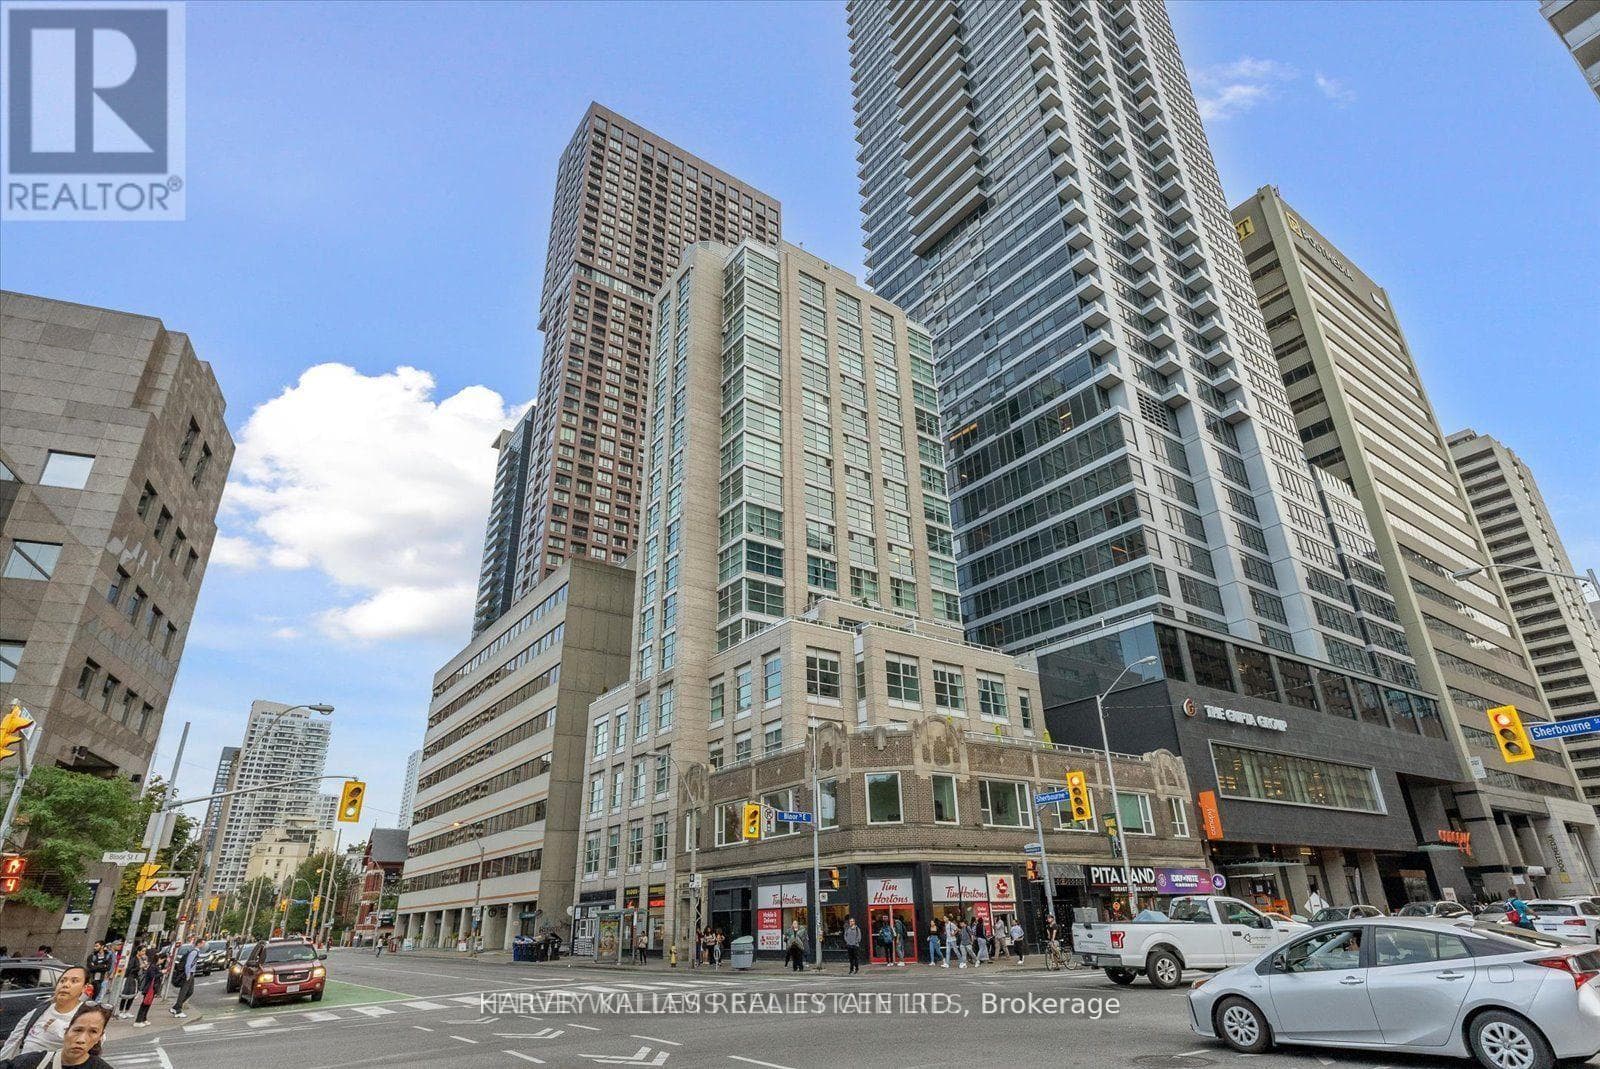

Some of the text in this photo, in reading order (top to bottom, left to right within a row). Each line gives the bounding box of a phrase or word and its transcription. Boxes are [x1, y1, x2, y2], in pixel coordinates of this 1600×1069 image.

[1533, 721, 1592, 738] Sherbourne
[1036, 793, 1066, 803] Sherbourne
[1090, 867, 1156, 884] PITA LAND
[880, 880, 898, 891] Tim
[782, 893, 803, 904] Hortons
[873, 892, 909, 904] Hortons
[945, 886, 960, 899] Tim
[958, 886, 987, 899] Hortons
